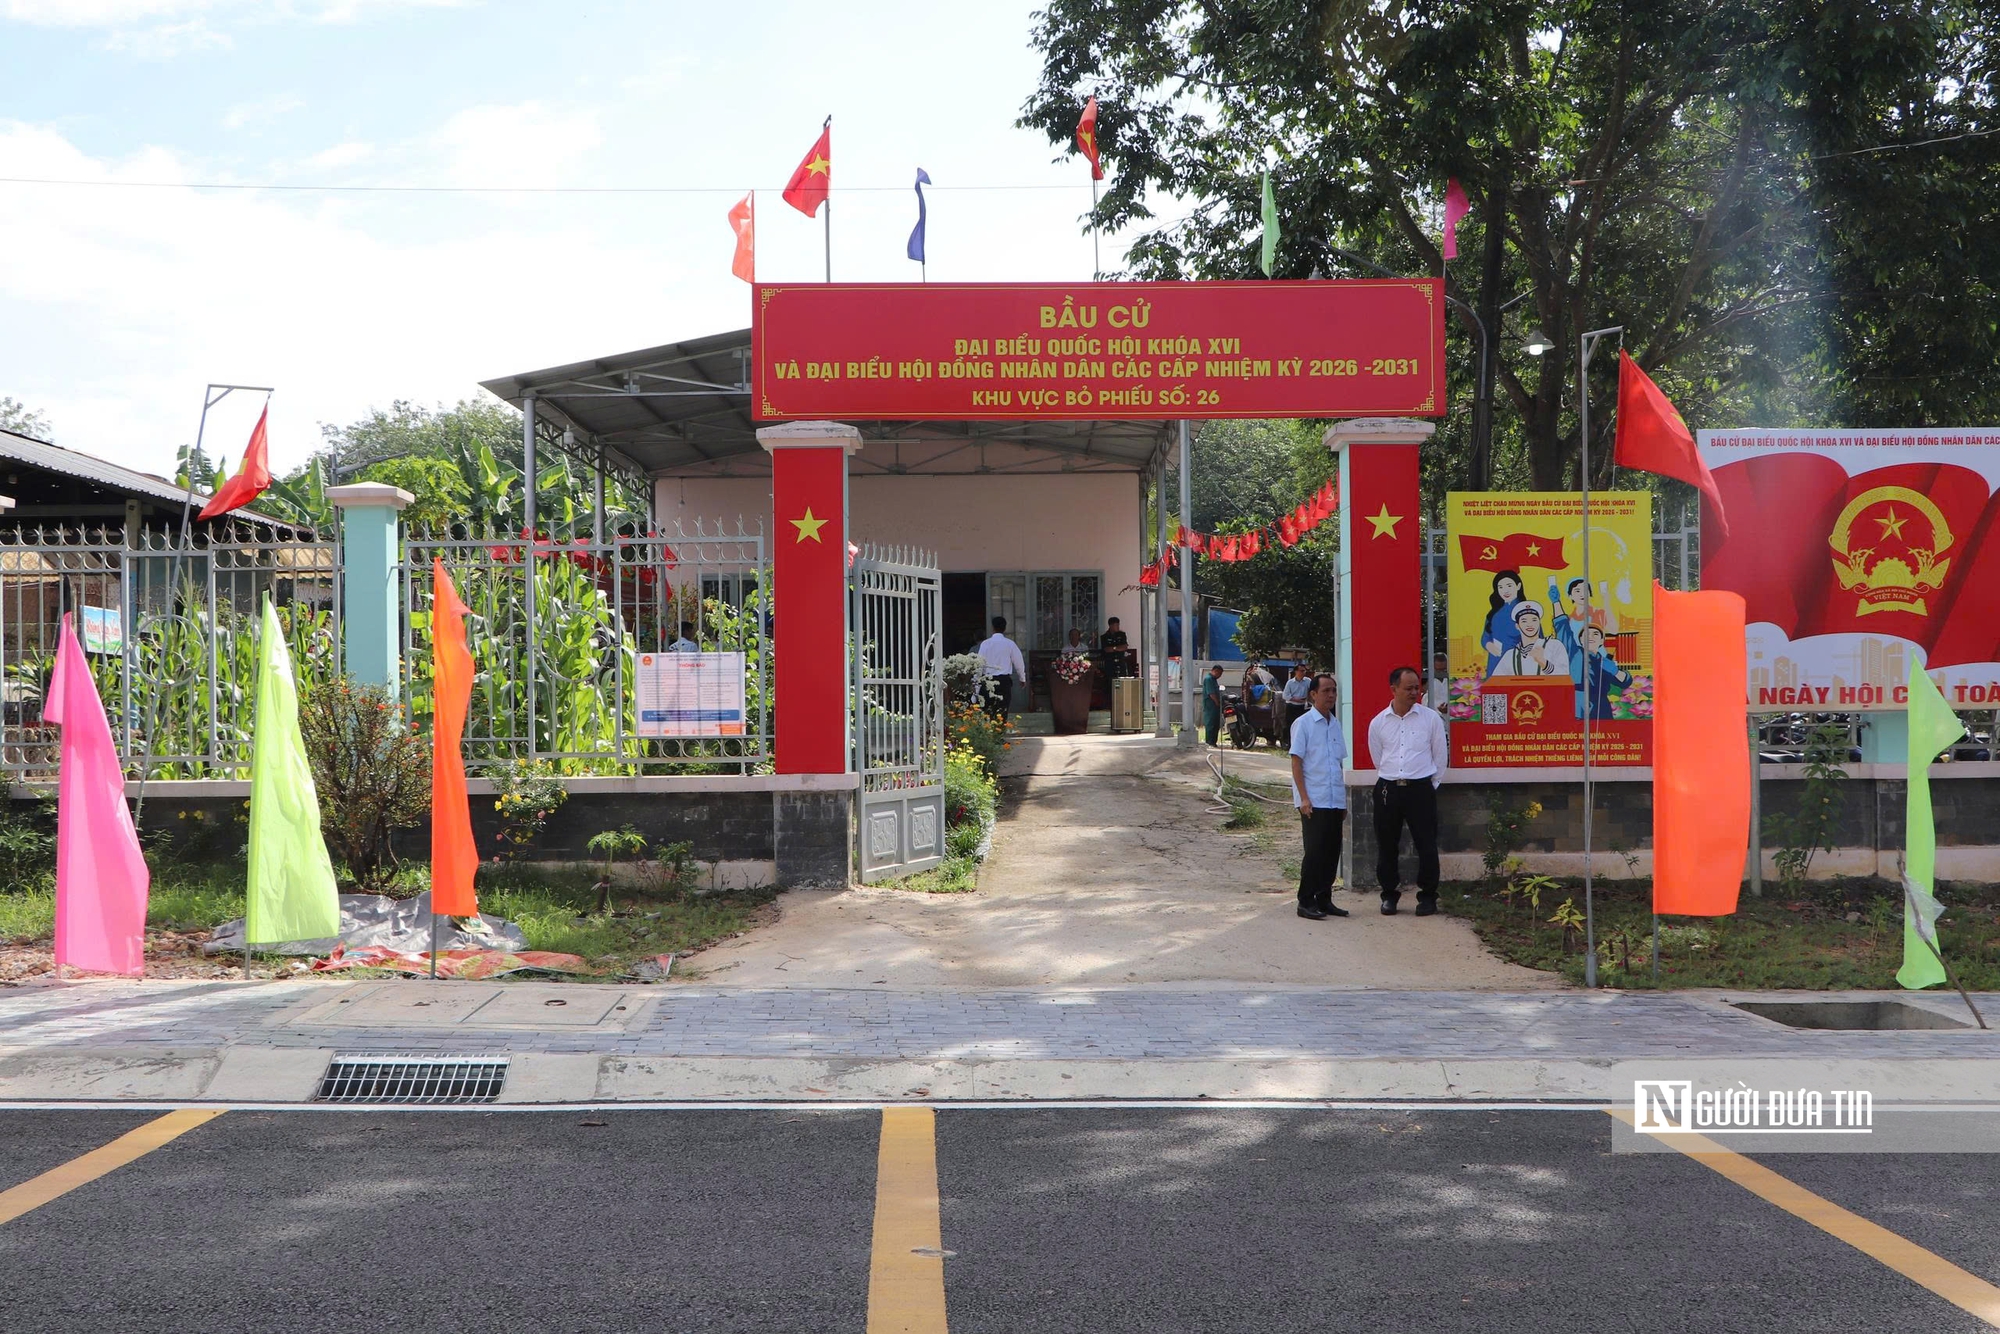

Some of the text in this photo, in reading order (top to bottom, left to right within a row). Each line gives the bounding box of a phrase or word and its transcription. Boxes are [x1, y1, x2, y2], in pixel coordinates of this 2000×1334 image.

[1040, 294, 1151, 328] BẦU CỬ
[955, 333, 1239, 358] ĐẠI BIỂU QUỐC HỘI KHÓA XVI
[774, 359, 800, 379] VÀ
[806, 363, 839, 382] ĐẠI
[847, 356, 892, 378] BIỂU
[899, 360, 931, 381] HỘI
[938, 356, 994, 378] ĐỒNG
[1000, 359, 1057, 378] NHÂN
[1064, 359, 1105, 378] DÂN
[1112, 358, 1151, 378] CÁC
[1159, 356, 1198, 377] CẤP
[1205, 357, 1271, 380] NHIỆM
[1278, 356, 1303, 376] KỲ
[1310, 360, 1357, 376] 2026
[973, 384, 1219, 409] KHU VỰC BỎ PHIẾU SỐ: 26
[1711, 436, 1726, 446] BẦU
[1729, 435, 1739, 446] CỬ
[1741, 438, 1754, 448] ĐẠI
[1757, 435, 1775, 446] BIỂU
[1778, 435, 1798, 447] QUỐC
[1801, 437, 1813, 448] HỘI
[1816, 436, 1837, 446] KHÓA
[1839, 438, 1851, 446] XVI
[1854, 436, 1864, 446] VÀ
[1866, 437, 1879, 448] ĐẠI
[1882, 434, 1899, 445] BIỂU
[1902, 436, 1915, 447] HỘI
[1917, 434, 1938, 445] ĐỒNG
[1941, 435, 1963, 445] NHÂN
[1966, 435, 1982, 445] DÂN
[1759, 683, 1830, 704] NGÀY
[1839, 683, 1882, 708] HỘI
